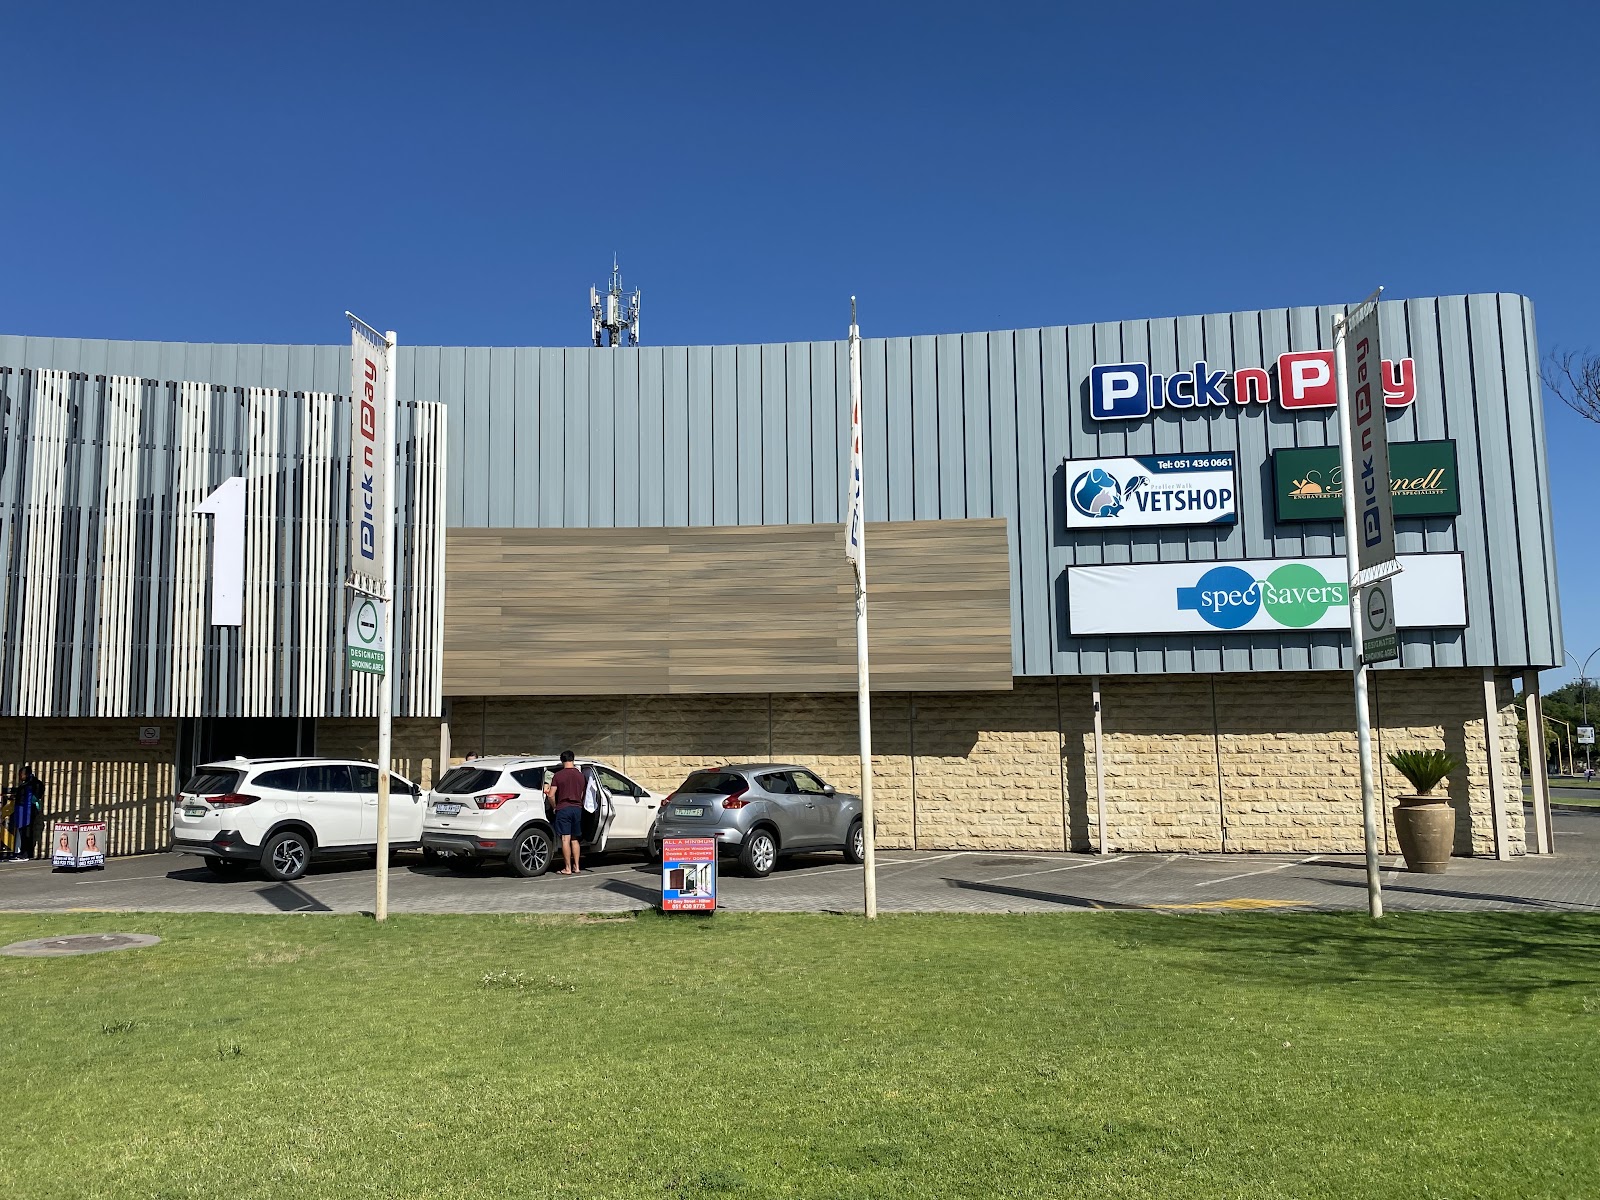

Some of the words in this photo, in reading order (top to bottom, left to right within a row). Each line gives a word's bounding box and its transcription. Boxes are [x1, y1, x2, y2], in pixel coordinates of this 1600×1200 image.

[1090, 361, 1229, 420] Pick
[1233, 367, 1270, 404] n
[1278, 350, 1416, 410] Py
[1355, 337, 1372, 427] Pay
[360, 358, 376, 442] Pay
[1362, 427, 1371, 451] n
[364, 445, 373, 468] n
[1157, 460, 1174, 469] Tel:
[1174, 459, 1190, 469] 051
[1191, 459, 1209, 468] 436
[1210, 458, 1232, 467] 0661
[1135, 489, 1232, 512] VETSHOP
[1361, 454, 1381, 548] Pick
[361, 471, 375, 560] Pick
[192, 477, 246, 626] 1
[1201, 588, 1257, 613] spec
[1267, 586, 1343, 605] savers
[350, 648, 385, 661] DESIGNATED
[1364, 636, 1396, 650] DESIGNATED
[351, 660, 372, 670] SMOKING
[372, 662, 385, 671] AREA
